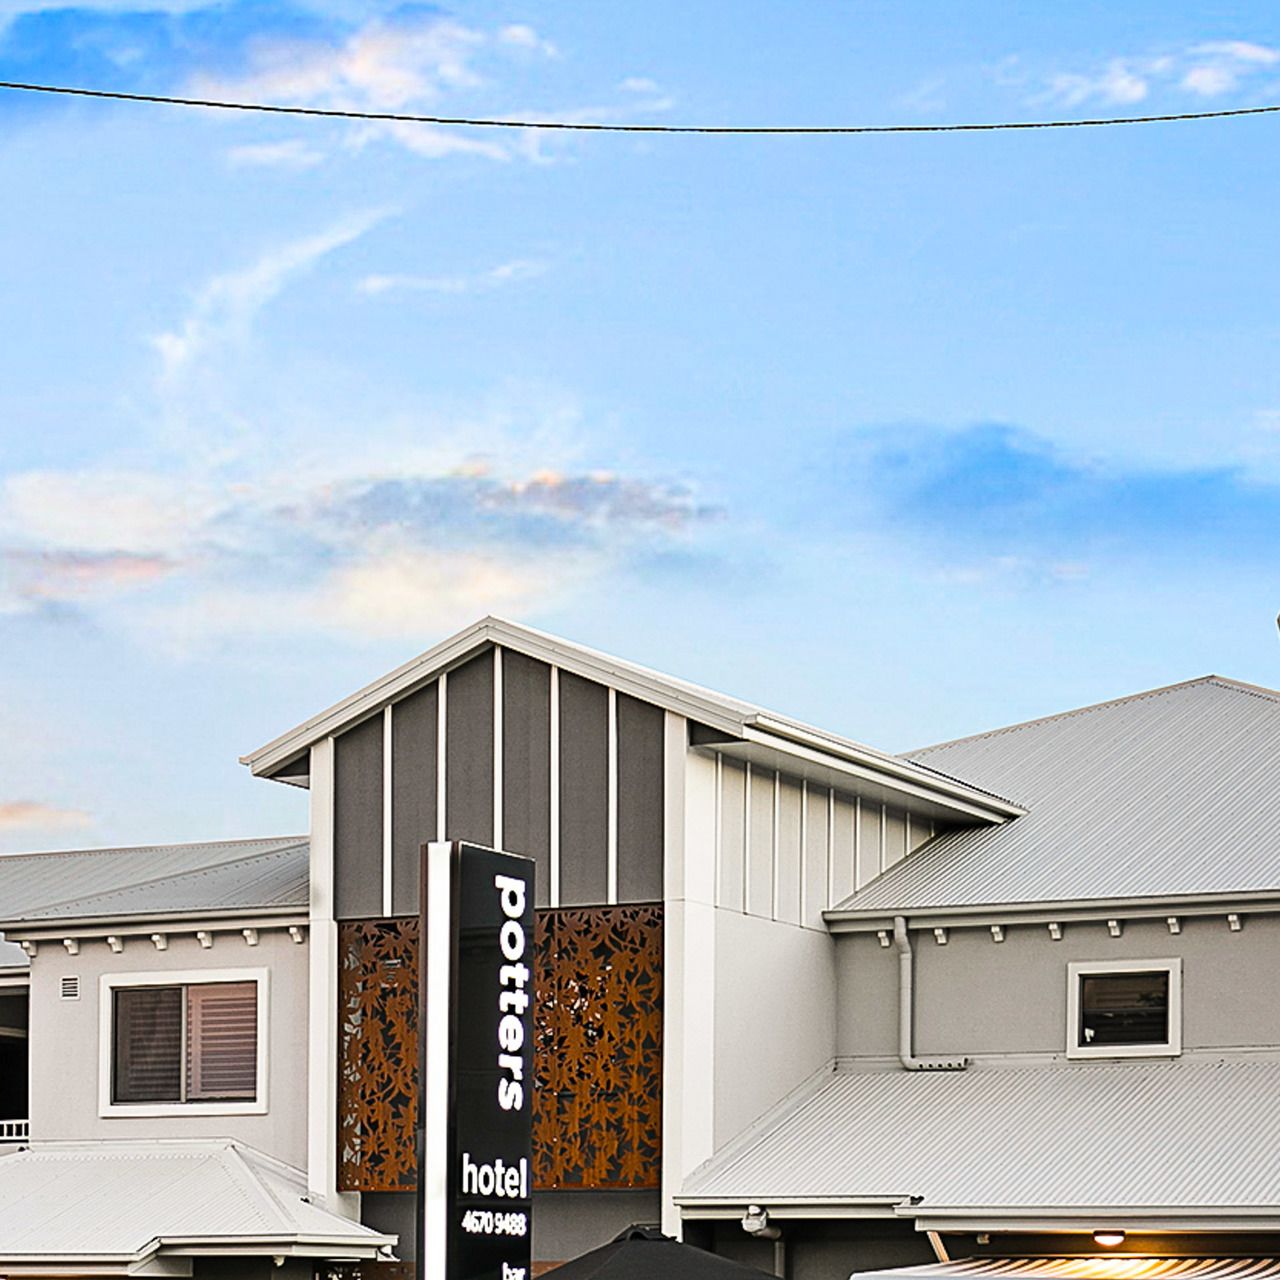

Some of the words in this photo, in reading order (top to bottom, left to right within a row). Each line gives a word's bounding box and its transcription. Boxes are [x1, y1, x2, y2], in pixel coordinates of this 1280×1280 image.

[495, 874, 529, 1112] potters
[462, 1153, 527, 1198] hotel
[461, 1210, 494, 1234] 4670
